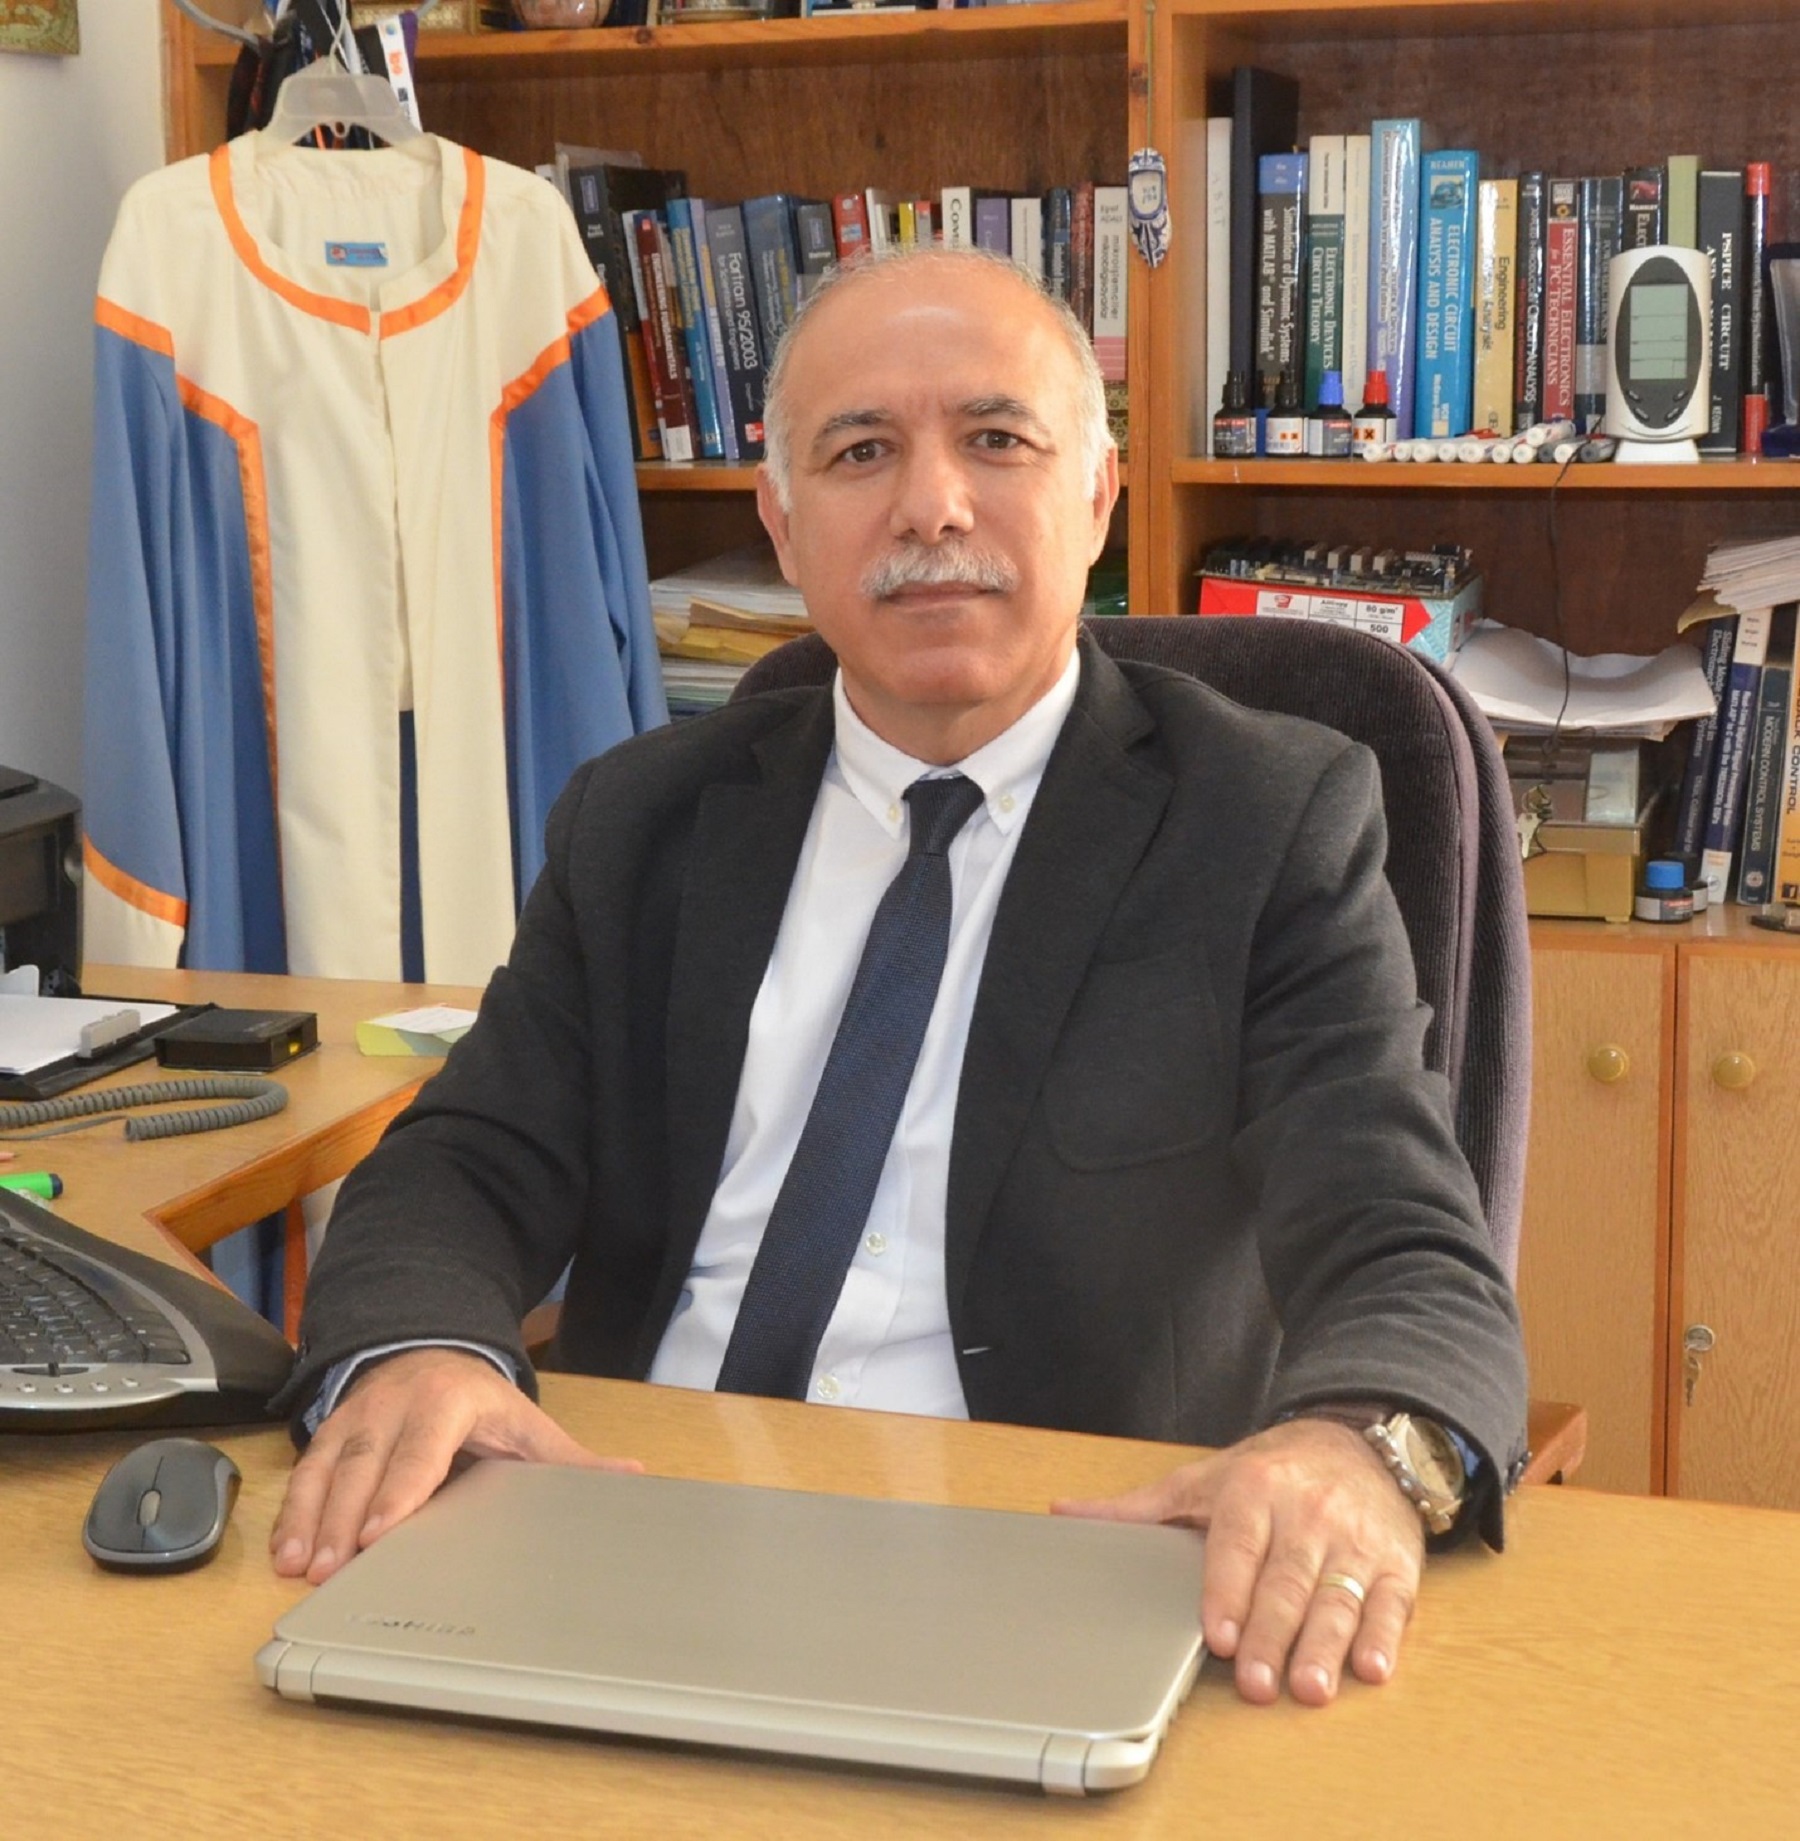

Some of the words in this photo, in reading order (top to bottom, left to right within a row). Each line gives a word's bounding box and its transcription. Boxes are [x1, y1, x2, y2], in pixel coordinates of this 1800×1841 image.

[1262, 209, 1276, 233] with
[1281, 206, 1298, 260] Simulation
[1282, 264, 1296, 274] of
[1310, 246, 1323, 294] CIRCUIT
[1428, 216, 1442, 276] ANALYSIS
[1445, 224, 1461, 299] ELECTRONIC
[1561, 227, 1575, 304] ESSENTIAL
[1721, 232, 1733, 291] PSPICE
[728, 252, 747, 309] Fortran
[1262, 286, 1276, 306] and
[1279, 277, 1298, 320] Dynamic
[1323, 246, 1338, 318] ELECTRONIC
[1427, 281, 1441, 308] AND
[1494, 256, 1510, 330] Engineering
[1550, 264, 1561, 285] PC
[724, 311, 736, 328] and
[736, 310, 758, 370] 95/2003
[1279, 323, 1296, 364] Systems
[1310, 297, 1323, 345] THEORY
[1425, 312, 1440, 359] DESIGN
[1443, 303, 1459, 353] CIRCUIT
[1547, 287, 1561, 385] TECHNICIANS
[1719, 303, 1732, 371] CIRCUIT
[726, 329, 741, 372] Engineers
[1322, 320, 1337, 369] DEVICES
[1558, 309, 1573, 406] ELECTRONICS
[1750, 312, 1762, 386] Synchronization
[1523, 351, 1538, 404] ANALYSIS
[1370, 624, 1389, 633] 500
[1716, 630, 1733, 665] Sliding
[1715, 665, 1727, 692] Mode
[1762, 715, 1775, 758] MODERN
[1756, 759, 1771, 804] CONTROL
[1786, 745, 1800, 815] CONTROL
[1750, 807, 1764, 852] SYSTEMS
